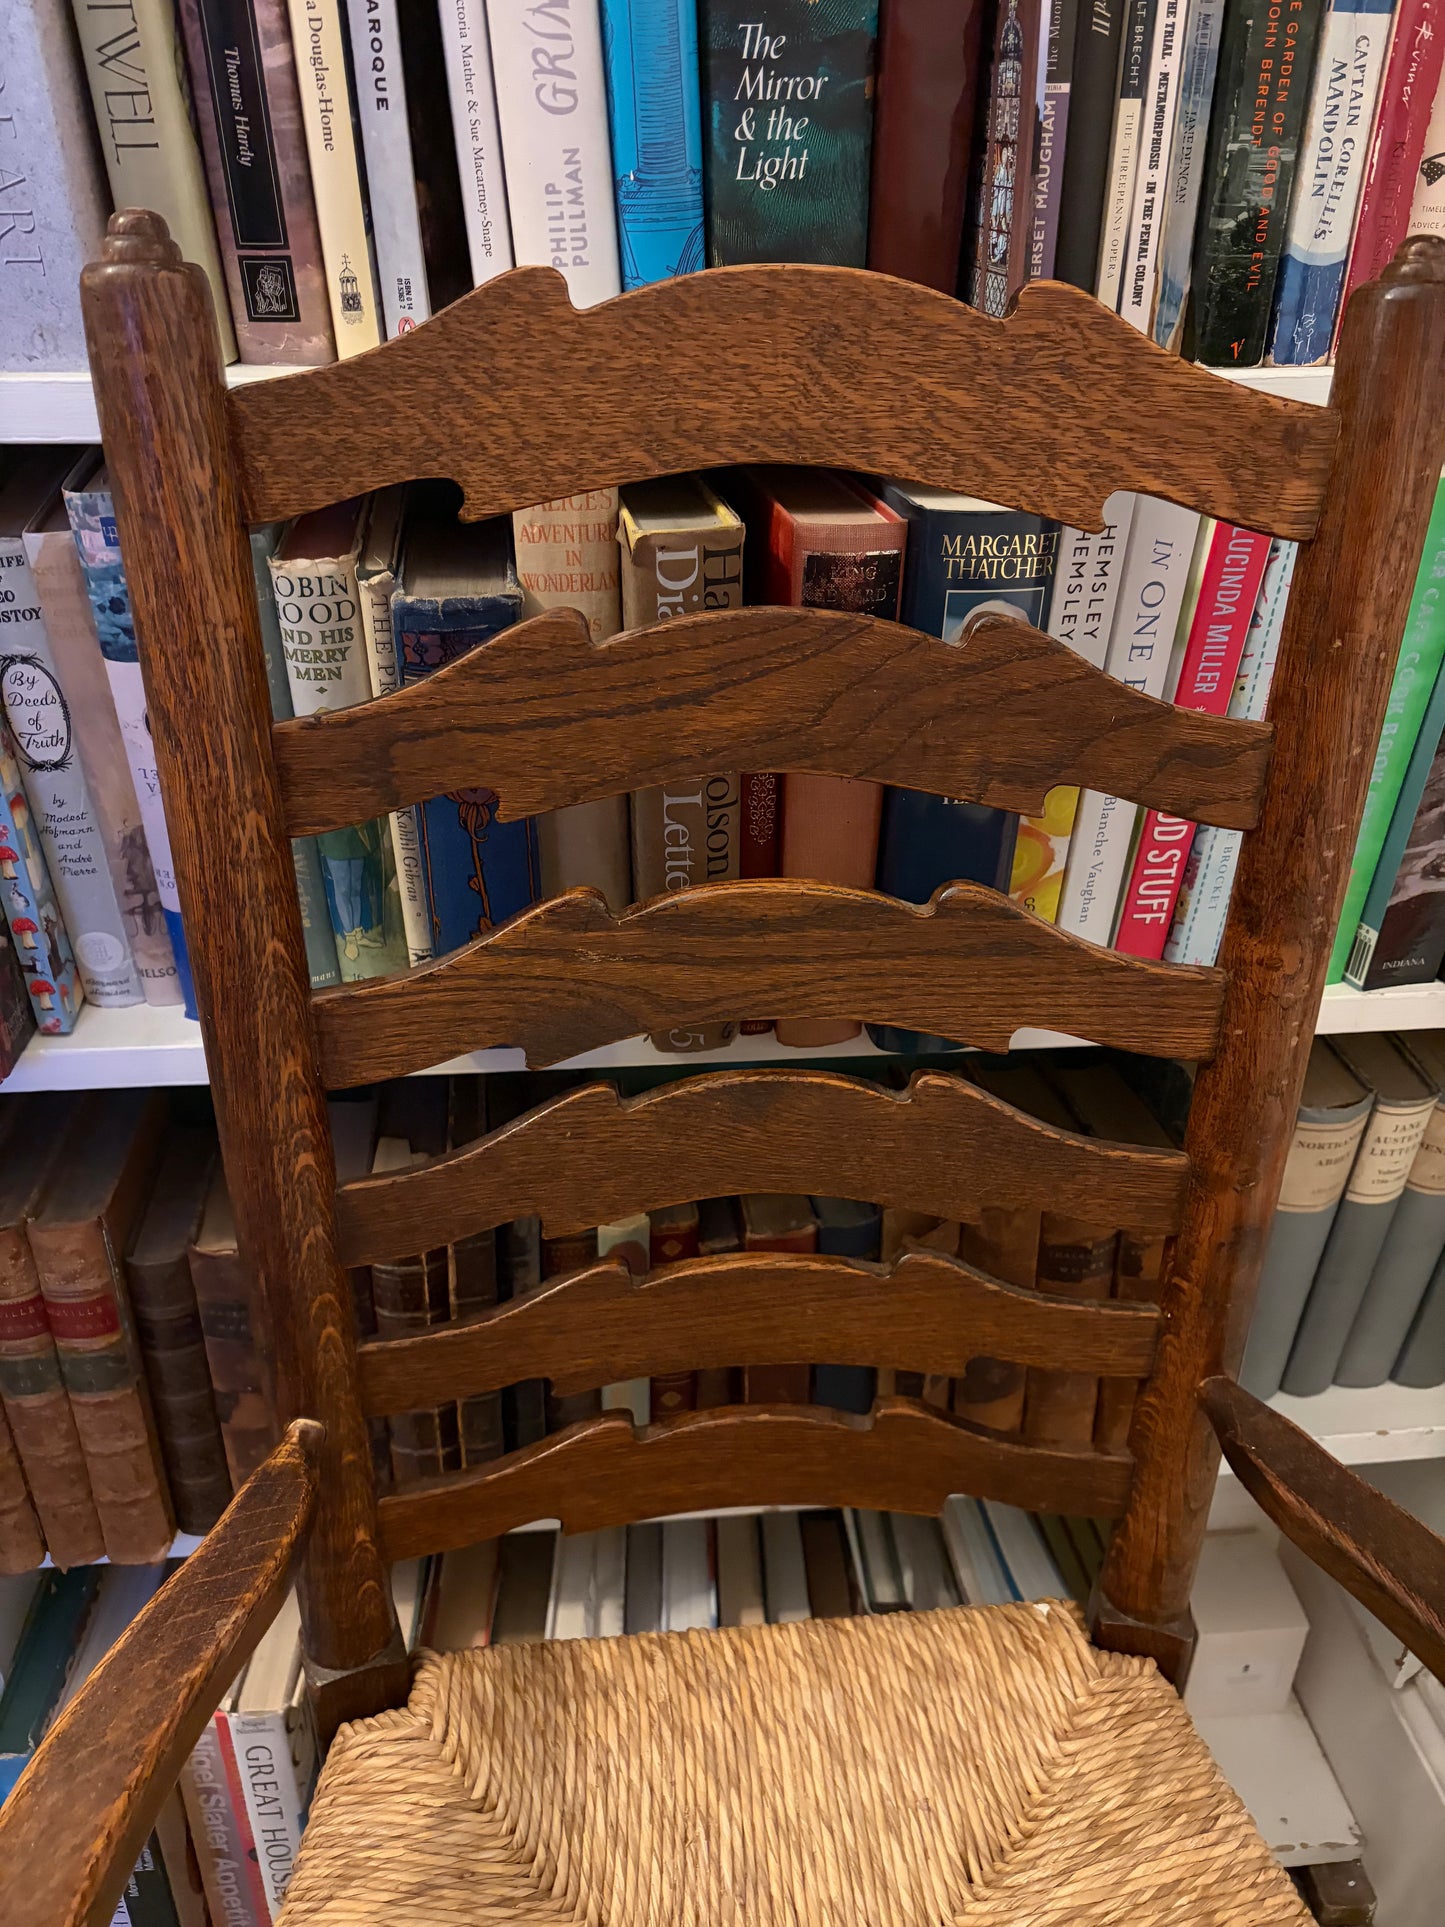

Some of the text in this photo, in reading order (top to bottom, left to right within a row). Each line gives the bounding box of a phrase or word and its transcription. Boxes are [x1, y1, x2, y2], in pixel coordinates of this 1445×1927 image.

[366, 0, 389, 111] AROQUE
[738, 24, 786, 60] The
[1130, 26, 1144, 86] BRECHT
[1162, 23, 1176, 60] TRIAL
[1276, 22, 1299, 102] GARDEN
[308, 17, 335, 152] Douglas-Home
[460, 44, 474, 95] Mather
[734, 66, 828, 101] Mirror
[1401, 20, 1434, 109] Runner
[224, 47, 254, 167] Thomas Hardy
[467, 101, 479, 112] &
[735, 105, 809, 141] & the
[1149, 72, 1170, 170] METAMORPHOSIS
[1250, 59, 1273, 147] BERENDT
[469, 120, 480, 142] Sue
[1272, 112, 1285, 136] OF
[1311, 58, 1348, 198] MANDOLIN
[1314, 35, 1370, 241] CAPTAIN CORELLI'S
[736, 148, 809, 191] Light
[1030, 100, 1056, 280] ERSET MAUGHAM
[1145, 182, 1157, 194] IN
[1175, 146, 1192, 204] DUNCAN
[1262, 146, 1280, 199] GOOD
[472, 147, 493, 258] Macartney-Snape
[567, 148, 589, 267] PULLMAN
[1107, 112, 1134, 279] THE THREEPENNY OPERA
[1142, 197, 1157, 221] THE
[545, 183, 568, 268] PHILIP
[1137, 224, 1153, 262] PENAL
[1255, 208, 1270, 243] AND
[1411, 221, 1440, 229] ADVICE
[1132, 265, 1147, 307] COLONY
[1246, 252, 1263, 292] EVIL
[565, 550, 583, 567] IN
[941, 531, 1061, 557] MARGARET
[275, 574, 349, 598] OBIN
[943, 556, 1053, 580] THATCHER
[1084, 525, 1117, 640] HEMSLEY
[371, 594, 390, 654] THE
[1128, 581, 1166, 662] ONE
[1193, 527, 1254, 694] LUCINDA MILLER
[281, 627, 354, 645] ND HIS
[284, 646, 351, 663] MERRY
[9, 671, 39, 689] By
[294, 666, 343, 681] MEN
[7, 690, 57, 707] Deeds
[19, 731, 65, 751] Truth
[28, 710, 43, 733] of
[42, 812, 88, 823] Modest
[52, 794, 67, 808] by
[39, 825, 95, 839] Hofmann
[57, 840, 82, 850] and
[59, 866, 98, 877] Pierre
[396, 808, 421, 902] Kahlil Gibran
[1079, 796, 1117, 924] Blanche Vaughan
[1132, 847, 1181, 925] STUFF
[1207, 846, 1233, 912] BROCKET
[1382, 957, 1425, 970] INDIANA
[246, 1745, 284, 1819] GREAT
[199, 1794, 230, 1852] Slater
